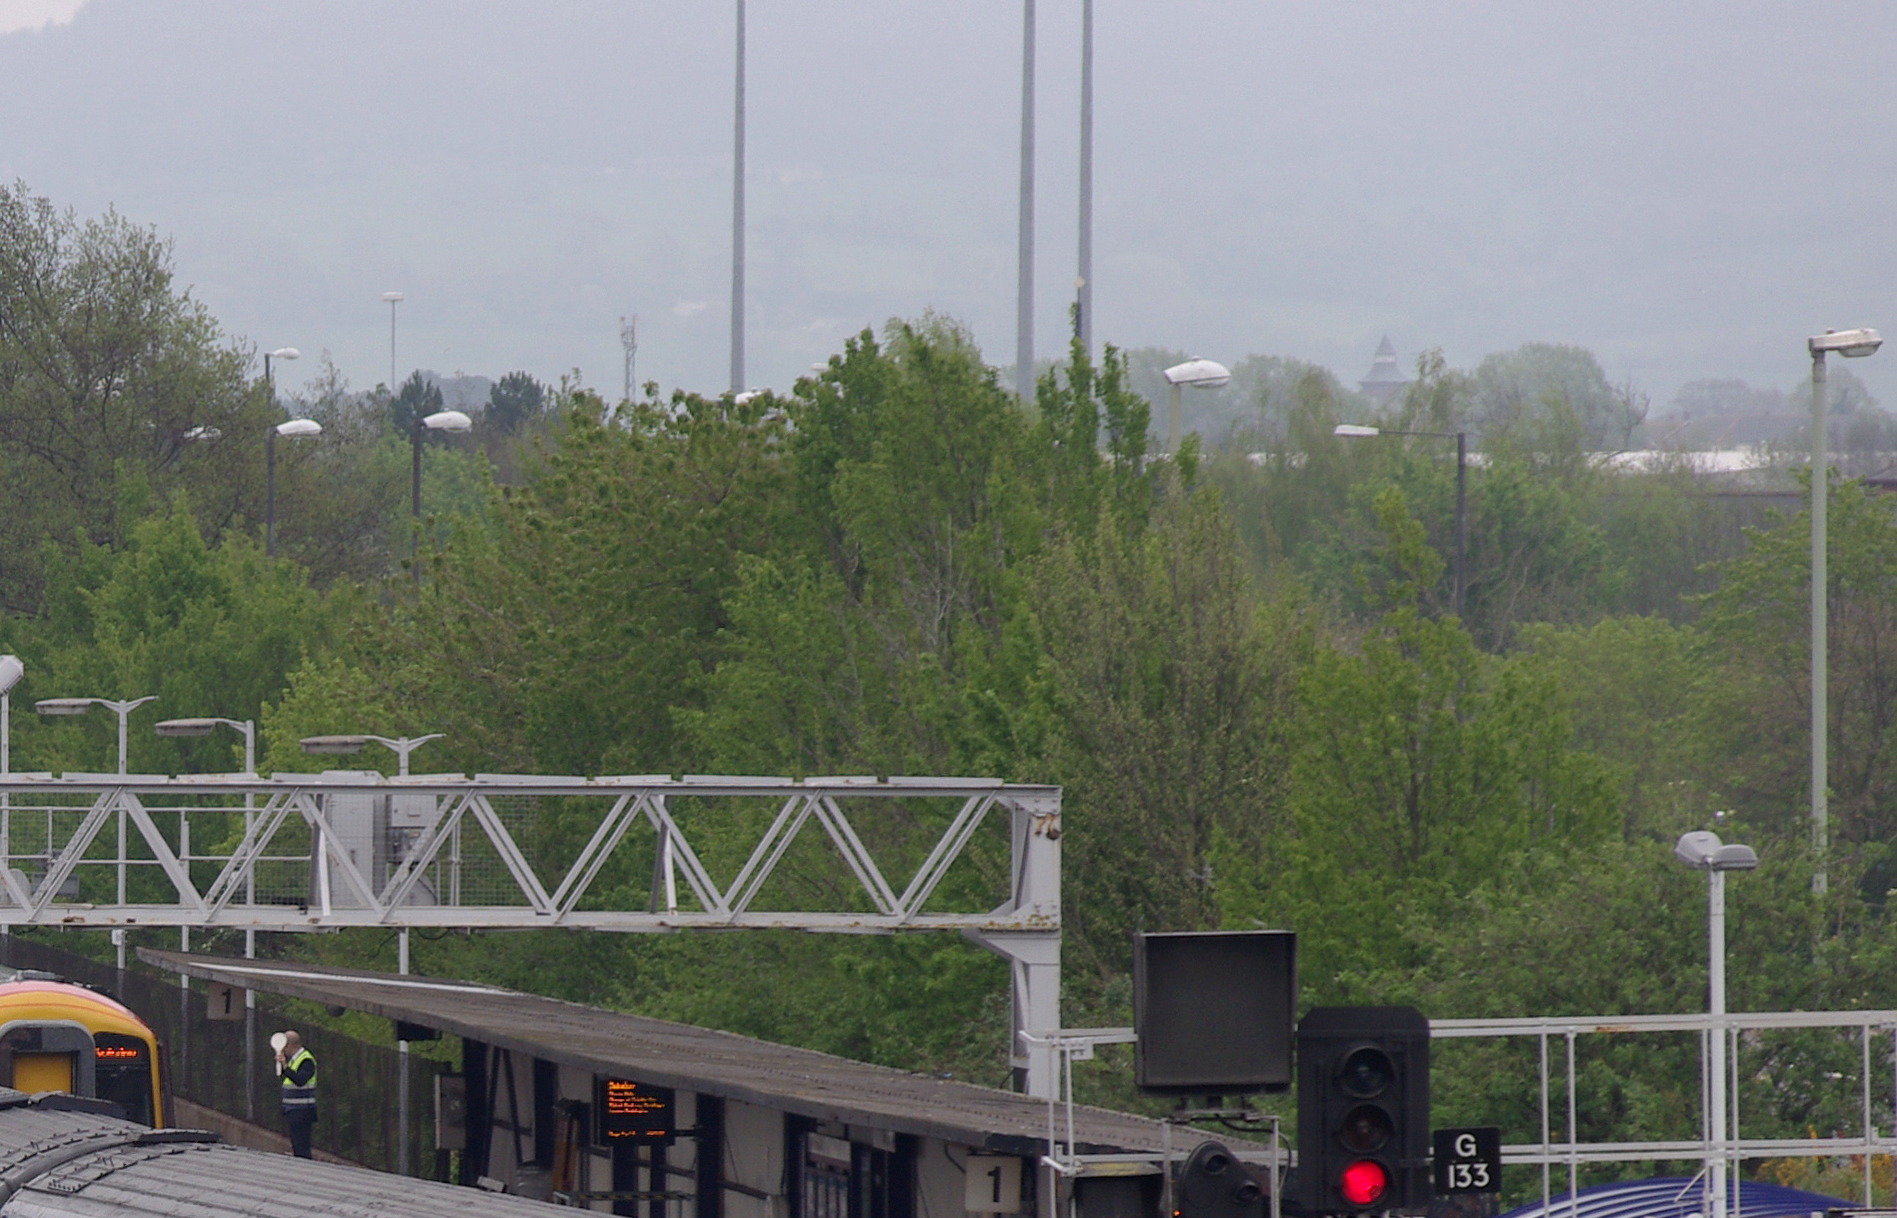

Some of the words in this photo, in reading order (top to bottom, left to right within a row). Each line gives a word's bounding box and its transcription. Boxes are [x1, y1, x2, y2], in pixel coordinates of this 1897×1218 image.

[221, 988, 233, 1015] 1
[1454, 1133, 1478, 1158] G
[987, 1165, 1002, 1203] 1
[1448, 1163, 1491, 1189] 133
